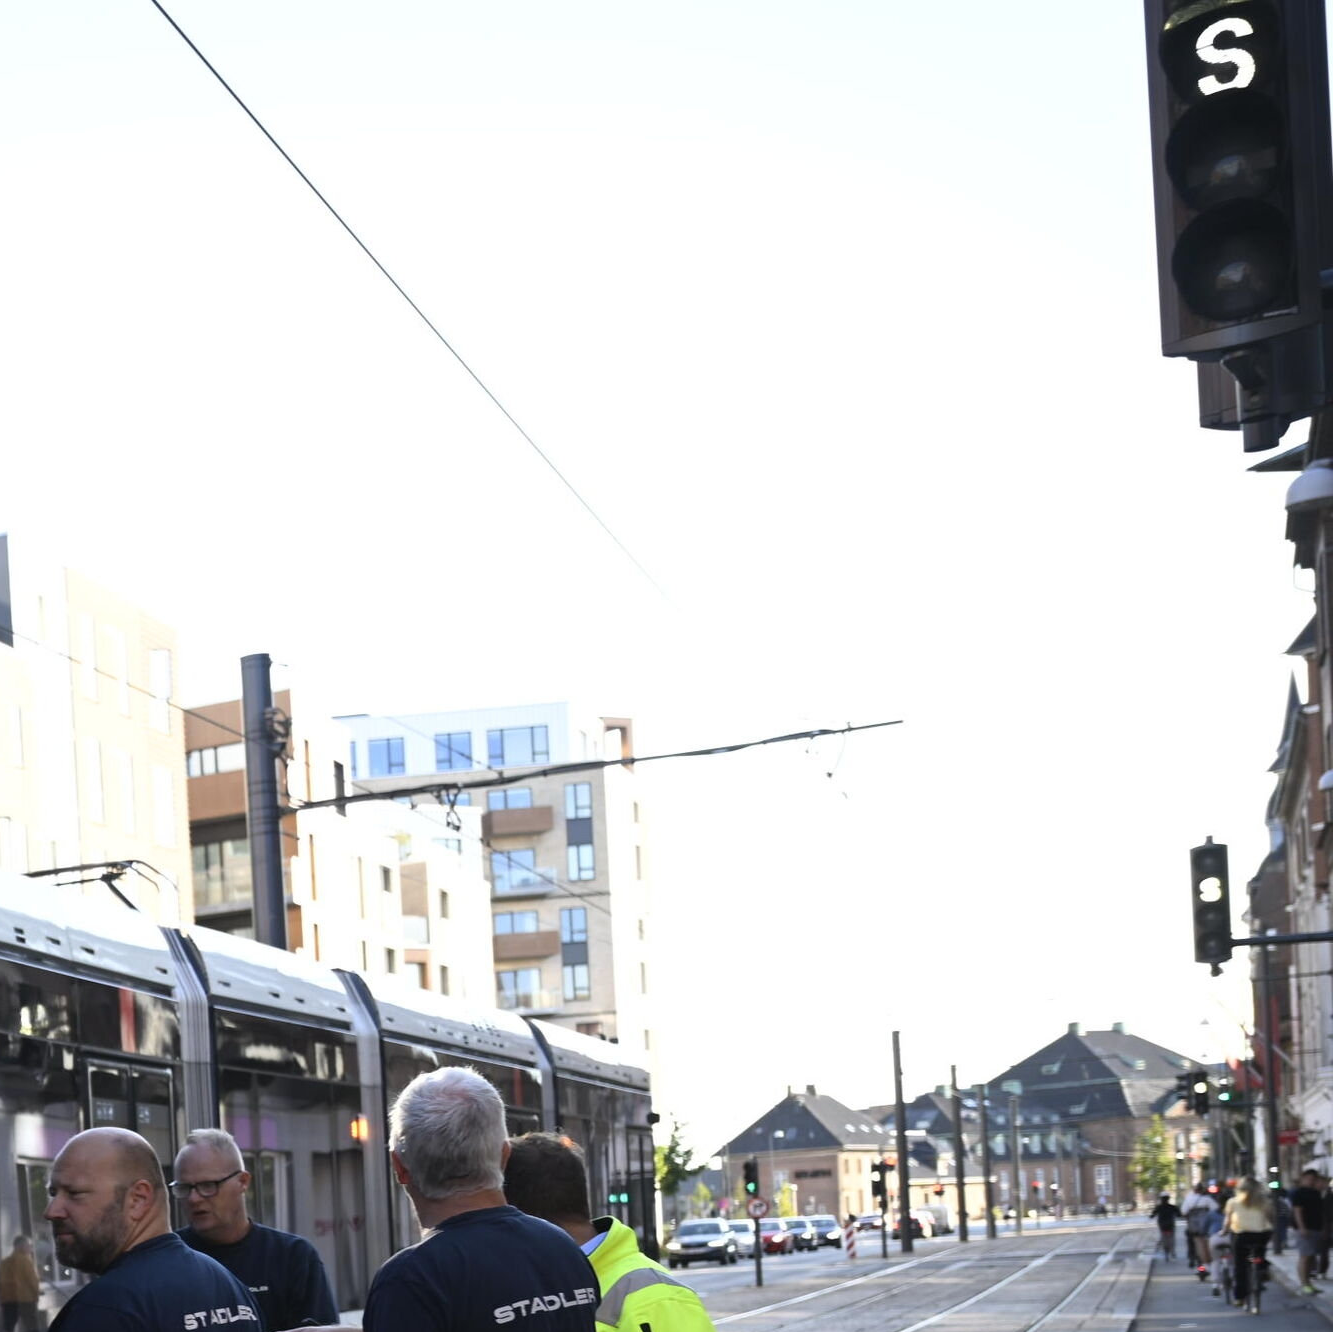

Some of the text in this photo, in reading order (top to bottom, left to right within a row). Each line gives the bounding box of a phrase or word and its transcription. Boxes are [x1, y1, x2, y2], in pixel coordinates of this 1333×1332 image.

[1195, 17, 1256, 96] S
[183, 1304, 257, 1331] STADLER
[493, 1287, 596, 1324] STADLER
